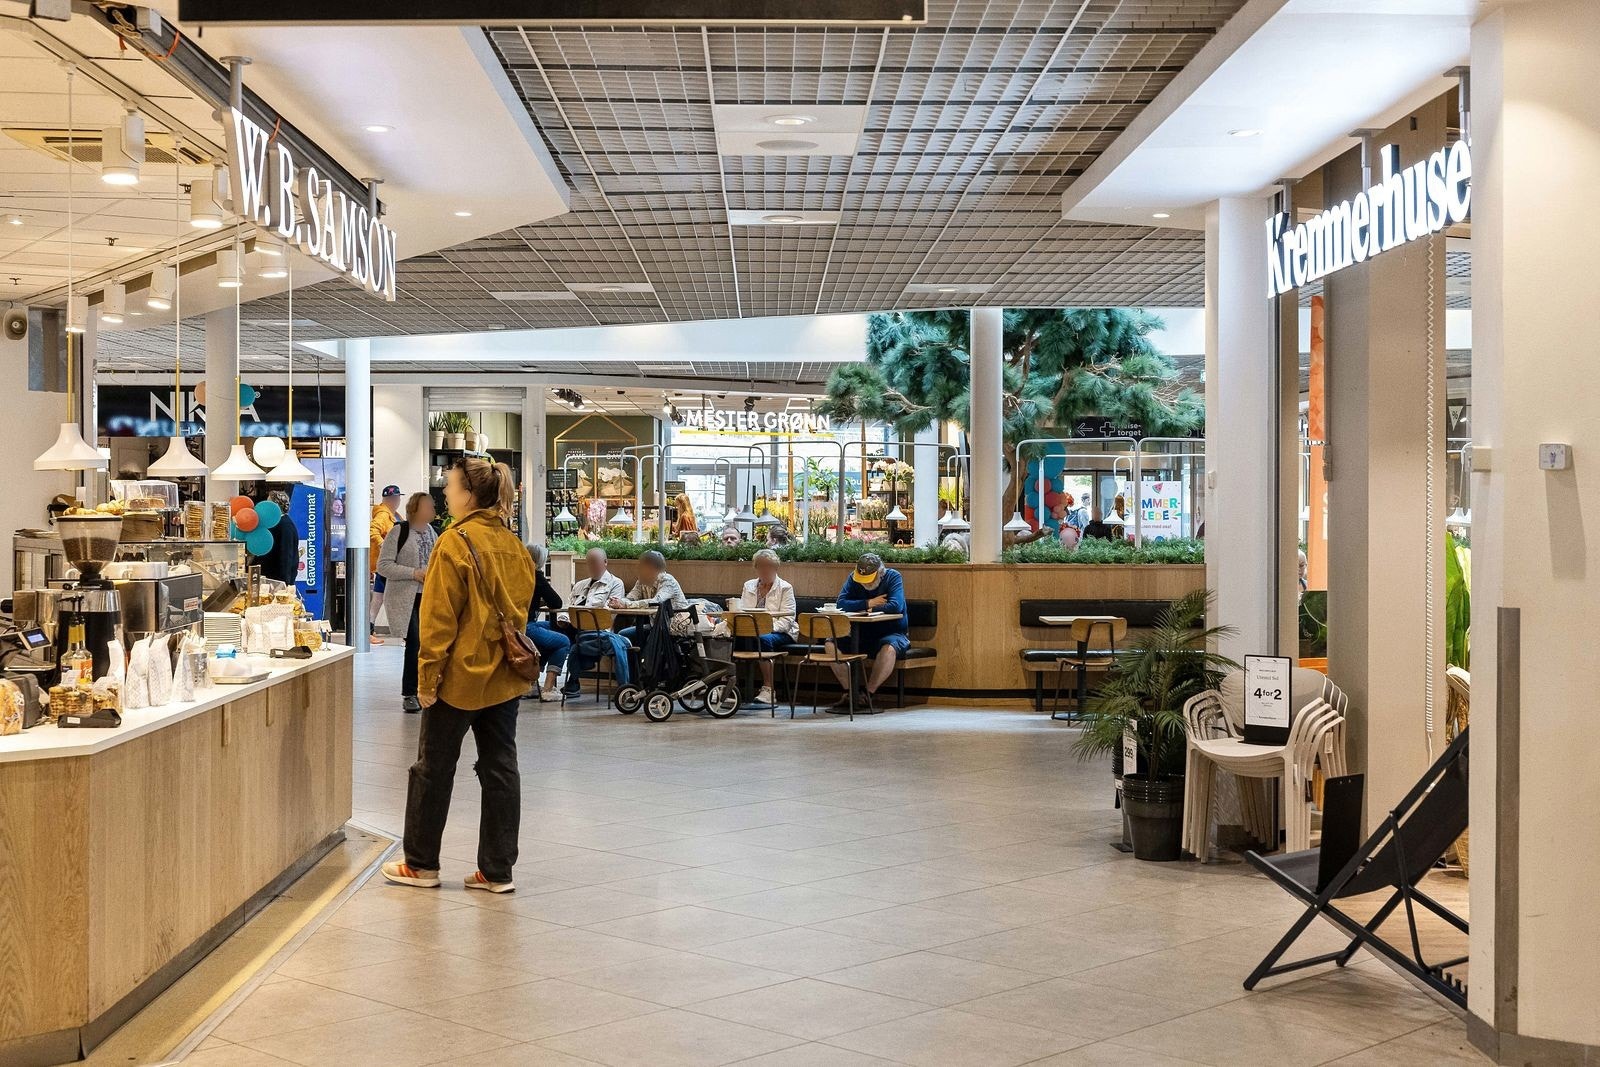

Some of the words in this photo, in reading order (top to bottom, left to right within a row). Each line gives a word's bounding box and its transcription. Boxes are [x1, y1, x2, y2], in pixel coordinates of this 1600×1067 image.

[307, 167, 397, 302] SAMSON
[1264, 139, 1472, 299] Kremmerhuse
[150, 391, 261, 423] NIKA
[685, 410, 760, 430] MESTER
[763, 411, 831, 432] GRØNN
[1126, 497, 1181, 509] SMMER-
[1142, 510, 1169, 521] LEDE
[306, 493, 316, 587] Gavekortautomat
